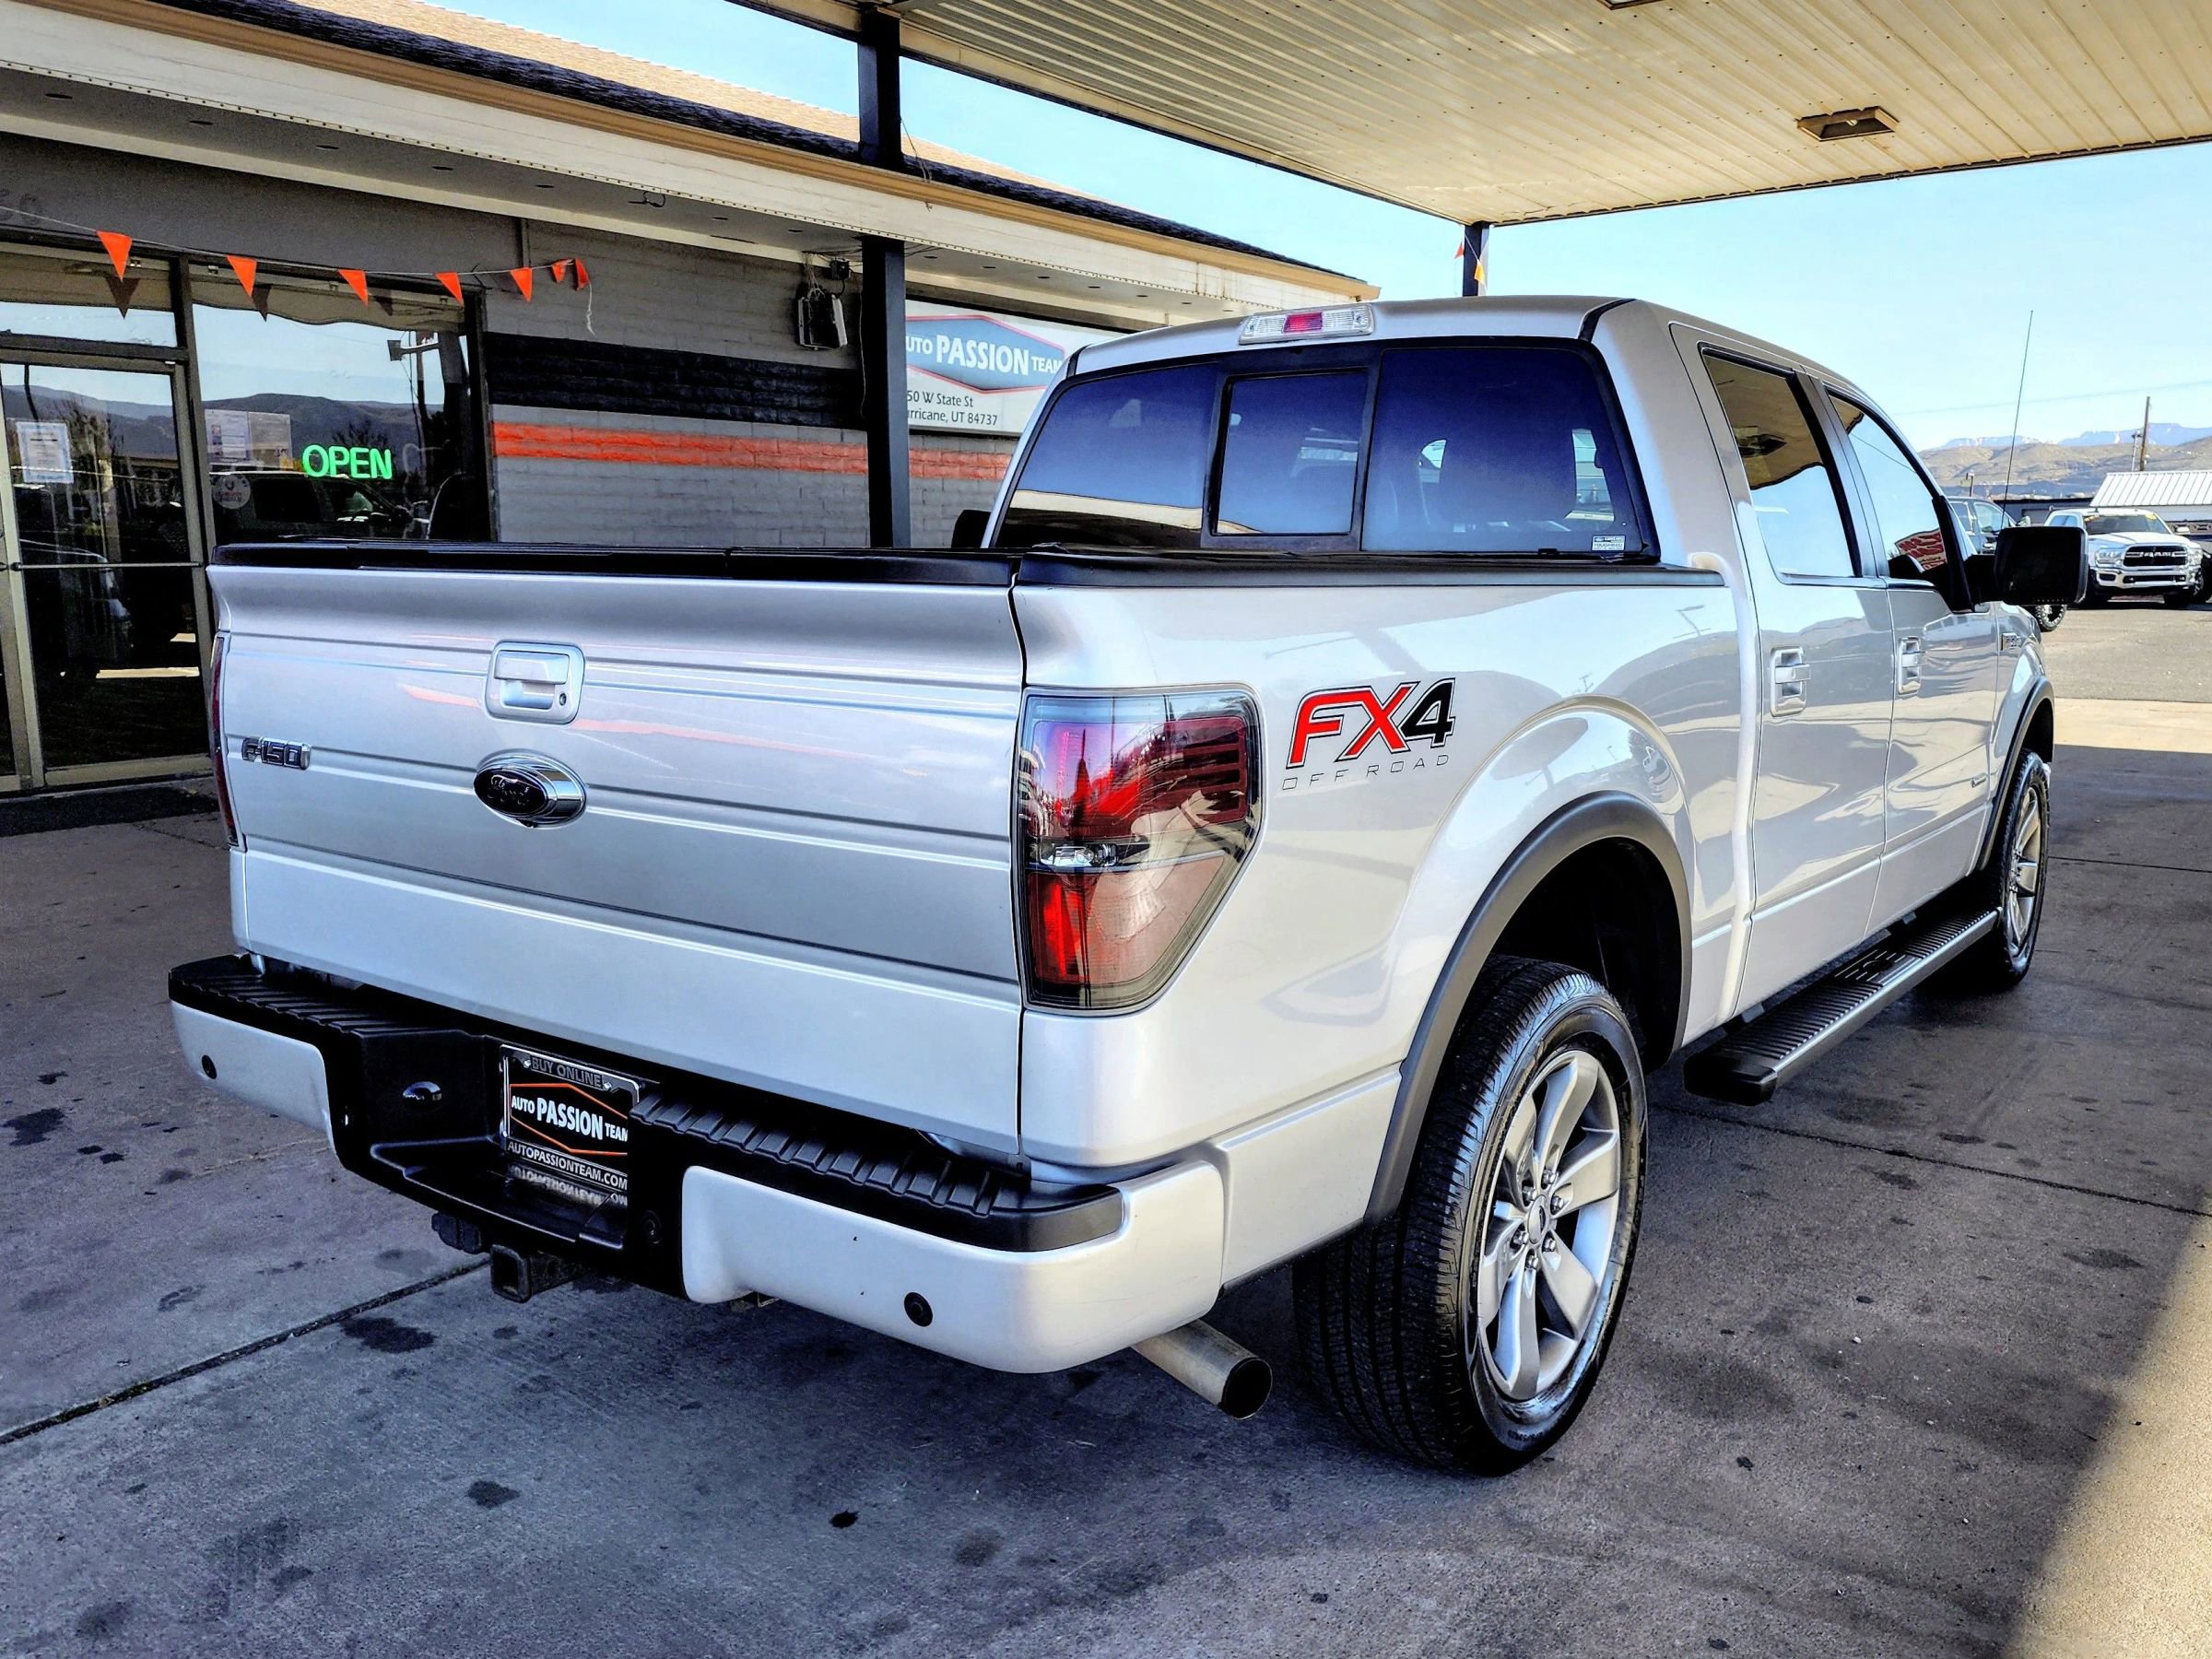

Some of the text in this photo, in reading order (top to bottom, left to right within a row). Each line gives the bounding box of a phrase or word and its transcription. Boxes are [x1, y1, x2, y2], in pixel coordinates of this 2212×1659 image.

[906, 335, 934, 355] UTO
[936, 335, 1030, 376] PASSION
[907, 390, 974, 407] 50 W State St
[951, 411, 965, 423] UT
[968, 413, 998, 426] 84737
[301, 444, 393, 479] OPEN
[1286, 677, 1456, 770] FX4
[1282, 754, 1450, 791] OFF ROAD
[531, 1056, 553, 1074] BUY
[511, 1095, 629, 1142] AUTO PASSION TEAM
[508, 1141, 628, 1191] AUTOPASSIONTEAM.COM
